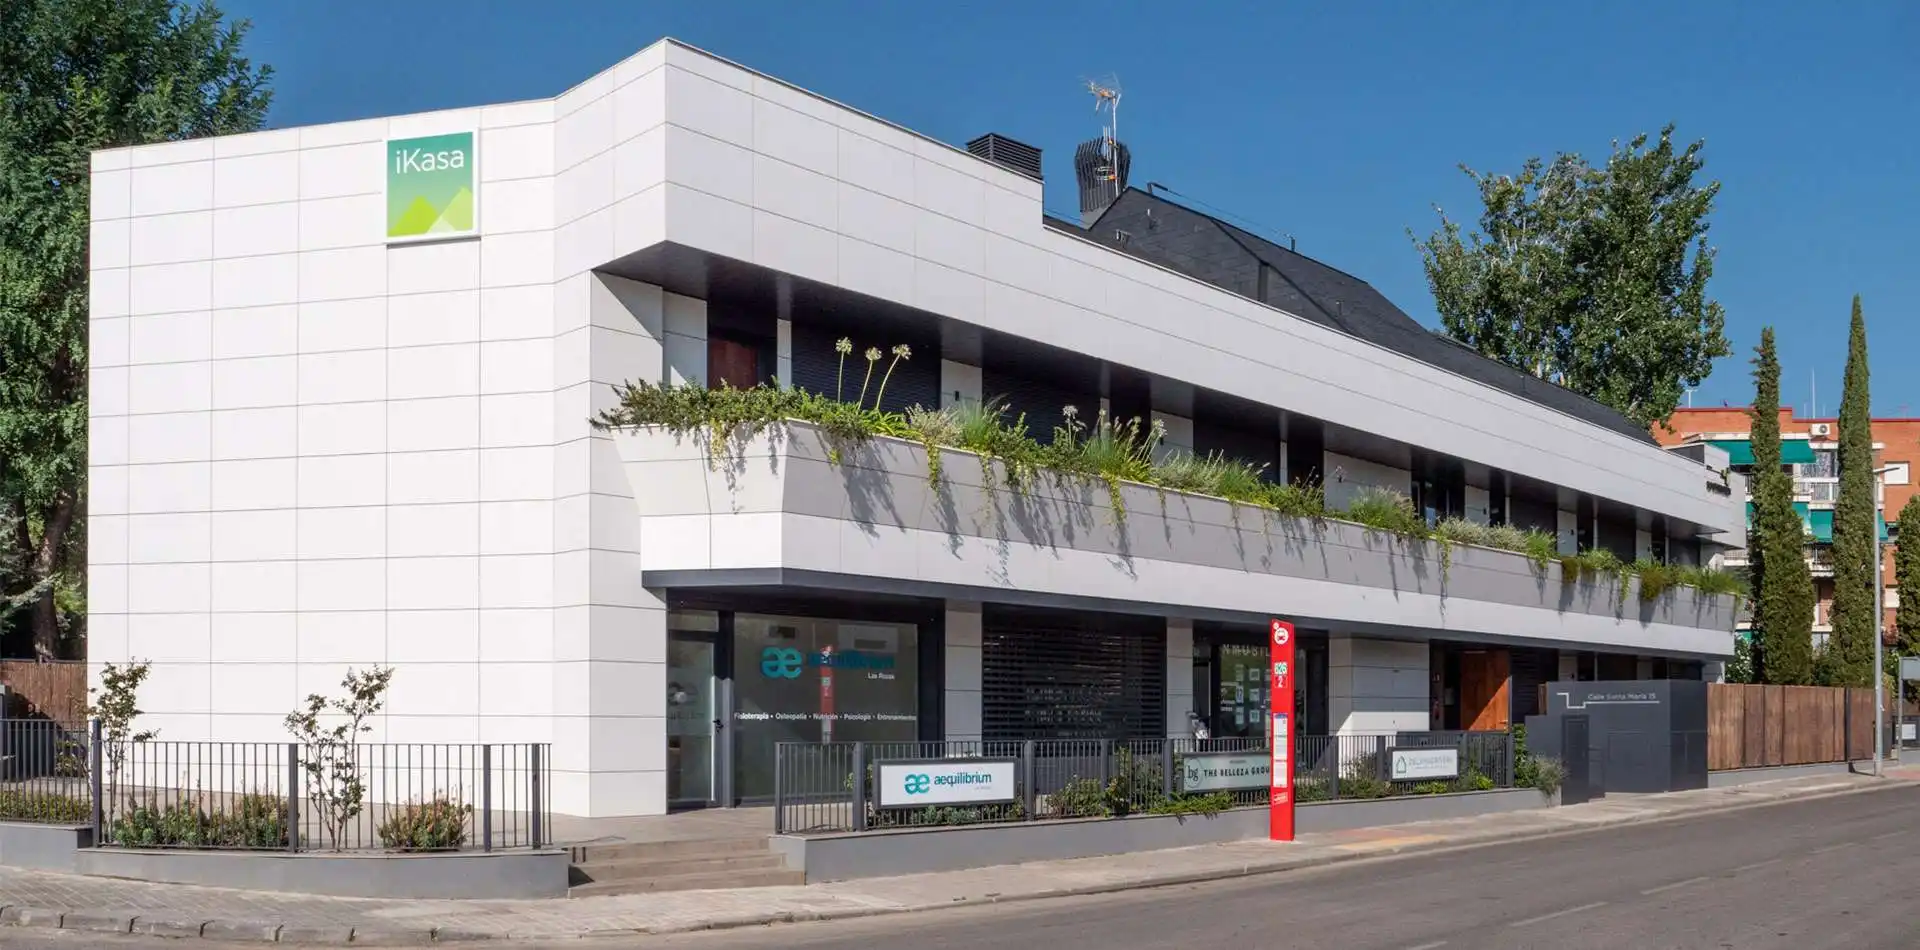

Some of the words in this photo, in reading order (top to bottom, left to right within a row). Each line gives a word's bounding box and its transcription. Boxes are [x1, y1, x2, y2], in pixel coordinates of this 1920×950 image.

[396, 148, 464, 174] iKasa
[933, 771, 992, 787] aequilibrium
[1187, 765, 1199, 782] bg
[1203, 769, 1218, 777] THE
[1220, 767, 1249, 777] BELLEZA
[1251, 765, 1270, 775] GROU
